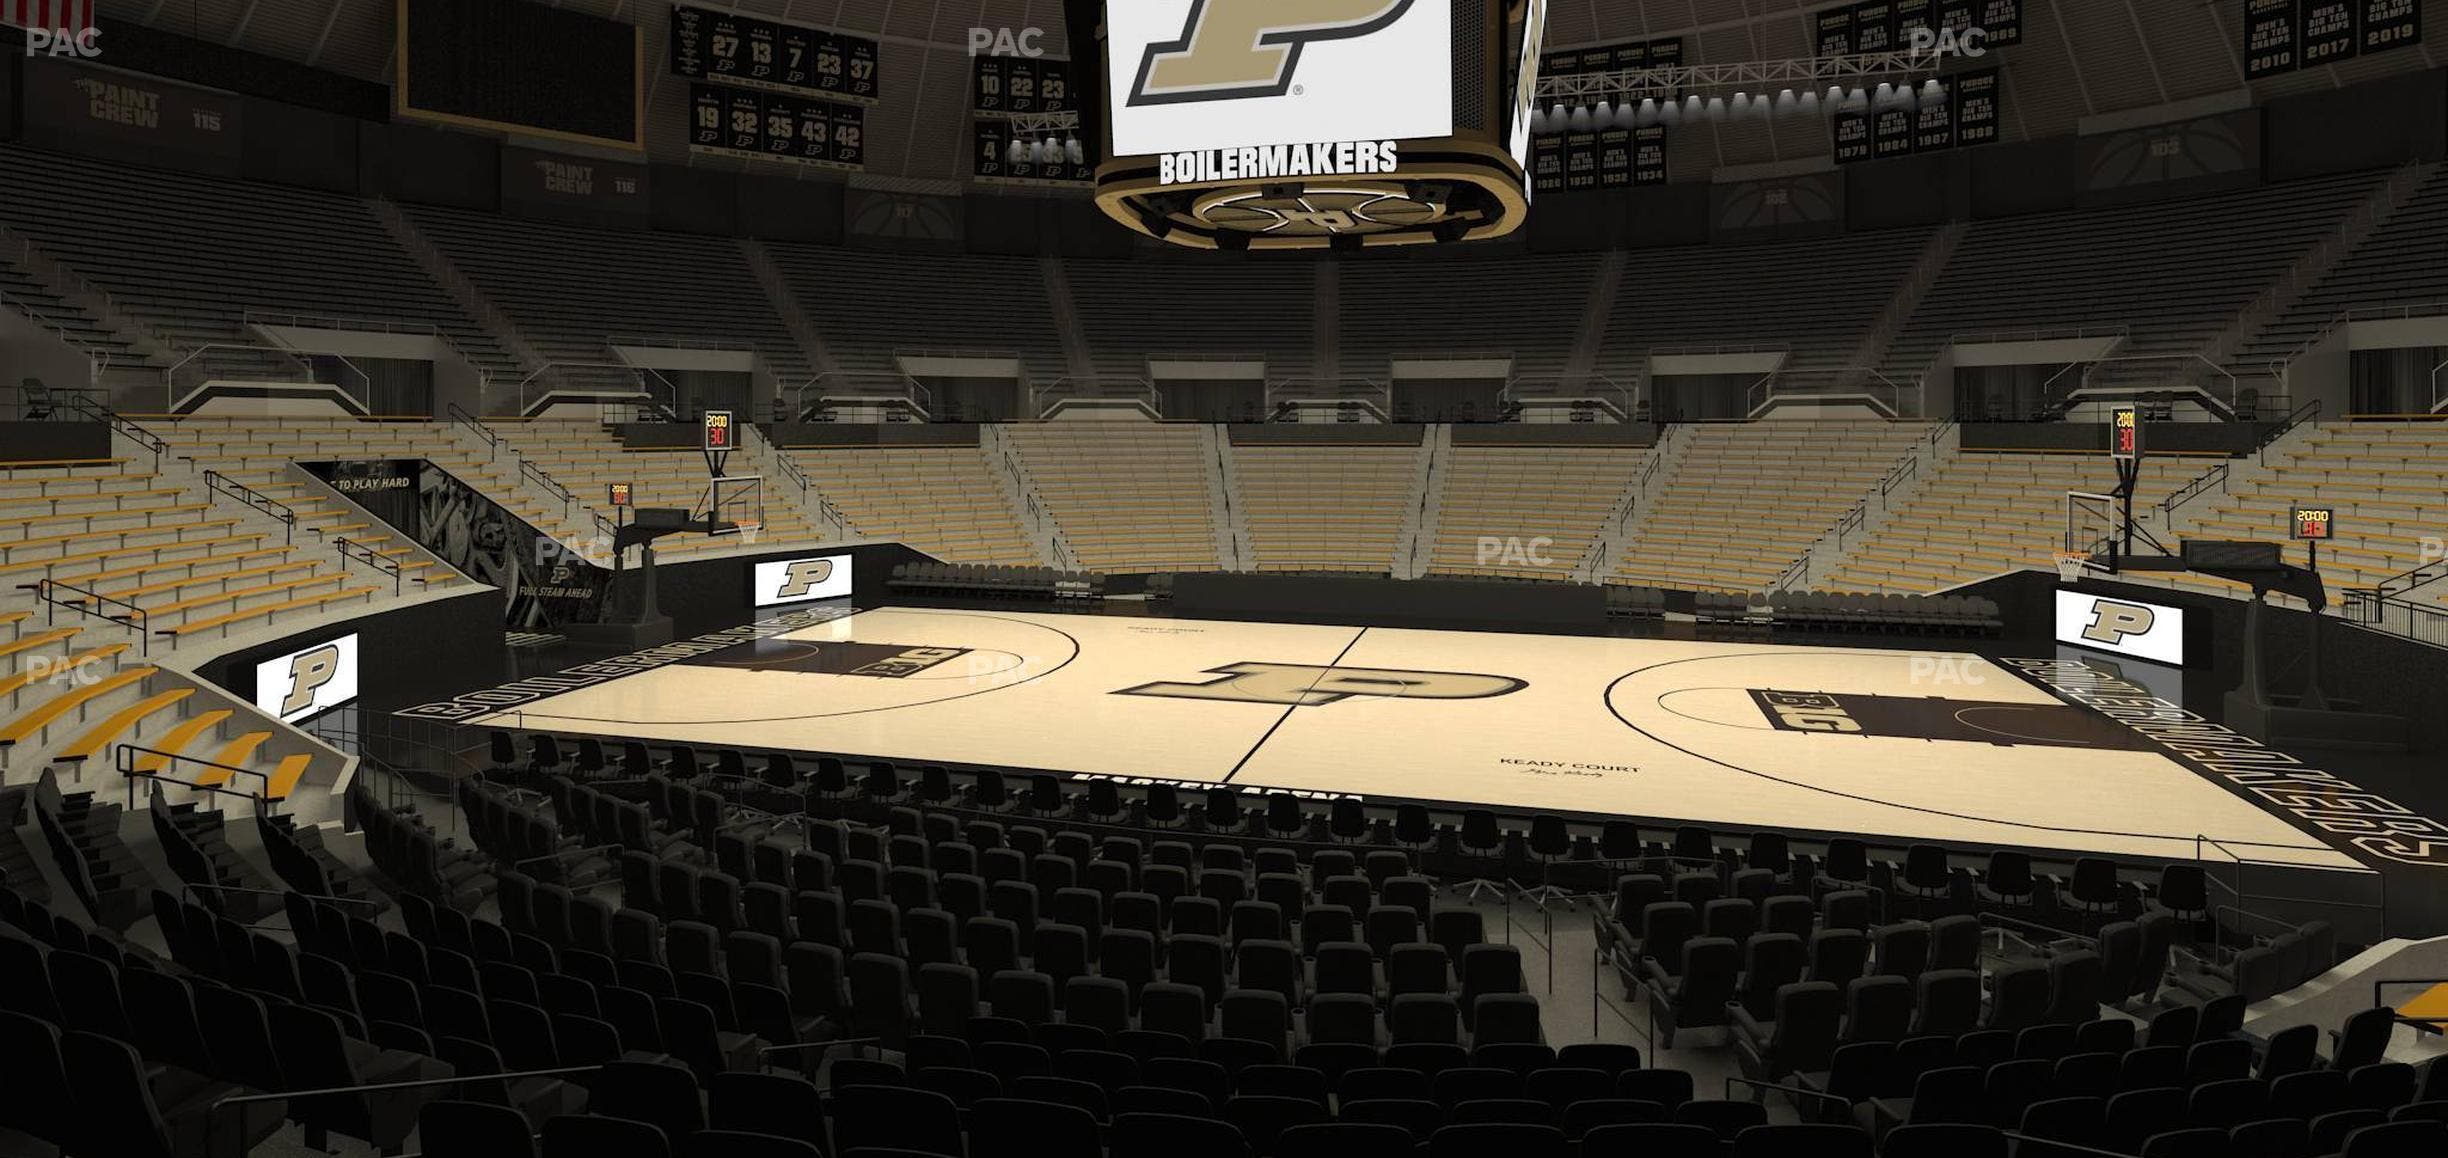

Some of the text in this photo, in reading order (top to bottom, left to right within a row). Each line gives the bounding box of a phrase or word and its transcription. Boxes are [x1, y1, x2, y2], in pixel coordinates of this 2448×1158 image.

[2368, 5, 2412, 22] CHAMPS
[2307, 20, 2349, 37] CHAMPS
[2367, 24, 2413, 45] 2019
[712, 34, 740, 58] 27
[751, 41, 772, 63] 13
[2306, 38, 2350, 60] 2017
[790, 48, 803, 69] 7
[817, 52, 841, 75] 23
[850, 58, 875, 80] 37
[2250, 52, 2290, 72] 2010
[981, 74, 1000, 94] 10
[1010, 77, 1034, 96] 22
[1041, 79, 1064, 99] 23
[87, 79, 161, 111] PAINT
[90, 98, 160, 129] CREW
[192, 112, 222, 132] 115
[697, 106, 719, 129] 19
[731, 111, 758, 134] 32
[768, 115, 793, 138] 35
[801, 121, 827, 142] 43
[834, 125, 861, 147] 42
[983, 141, 996, 161] 4
[545, 160, 593, 181] PAINT
[1160, 140, 1398, 185] BOILERMAKERS
[545, 176, 593, 196] CREW
[710, 428, 723, 445] 30
[339, 480, 351, 490] TO
[353, 479, 379, 489] PLAY
[382, 477, 410, 488] HARD
[2297, 510, 2329, 522] 20:00
[538, 587, 565, 598] STEAM
[565, 588, 593, 599] AHEAD
[1500, 757, 1565, 767] KEADY
[1572, 763, 1641, 773] COURT
